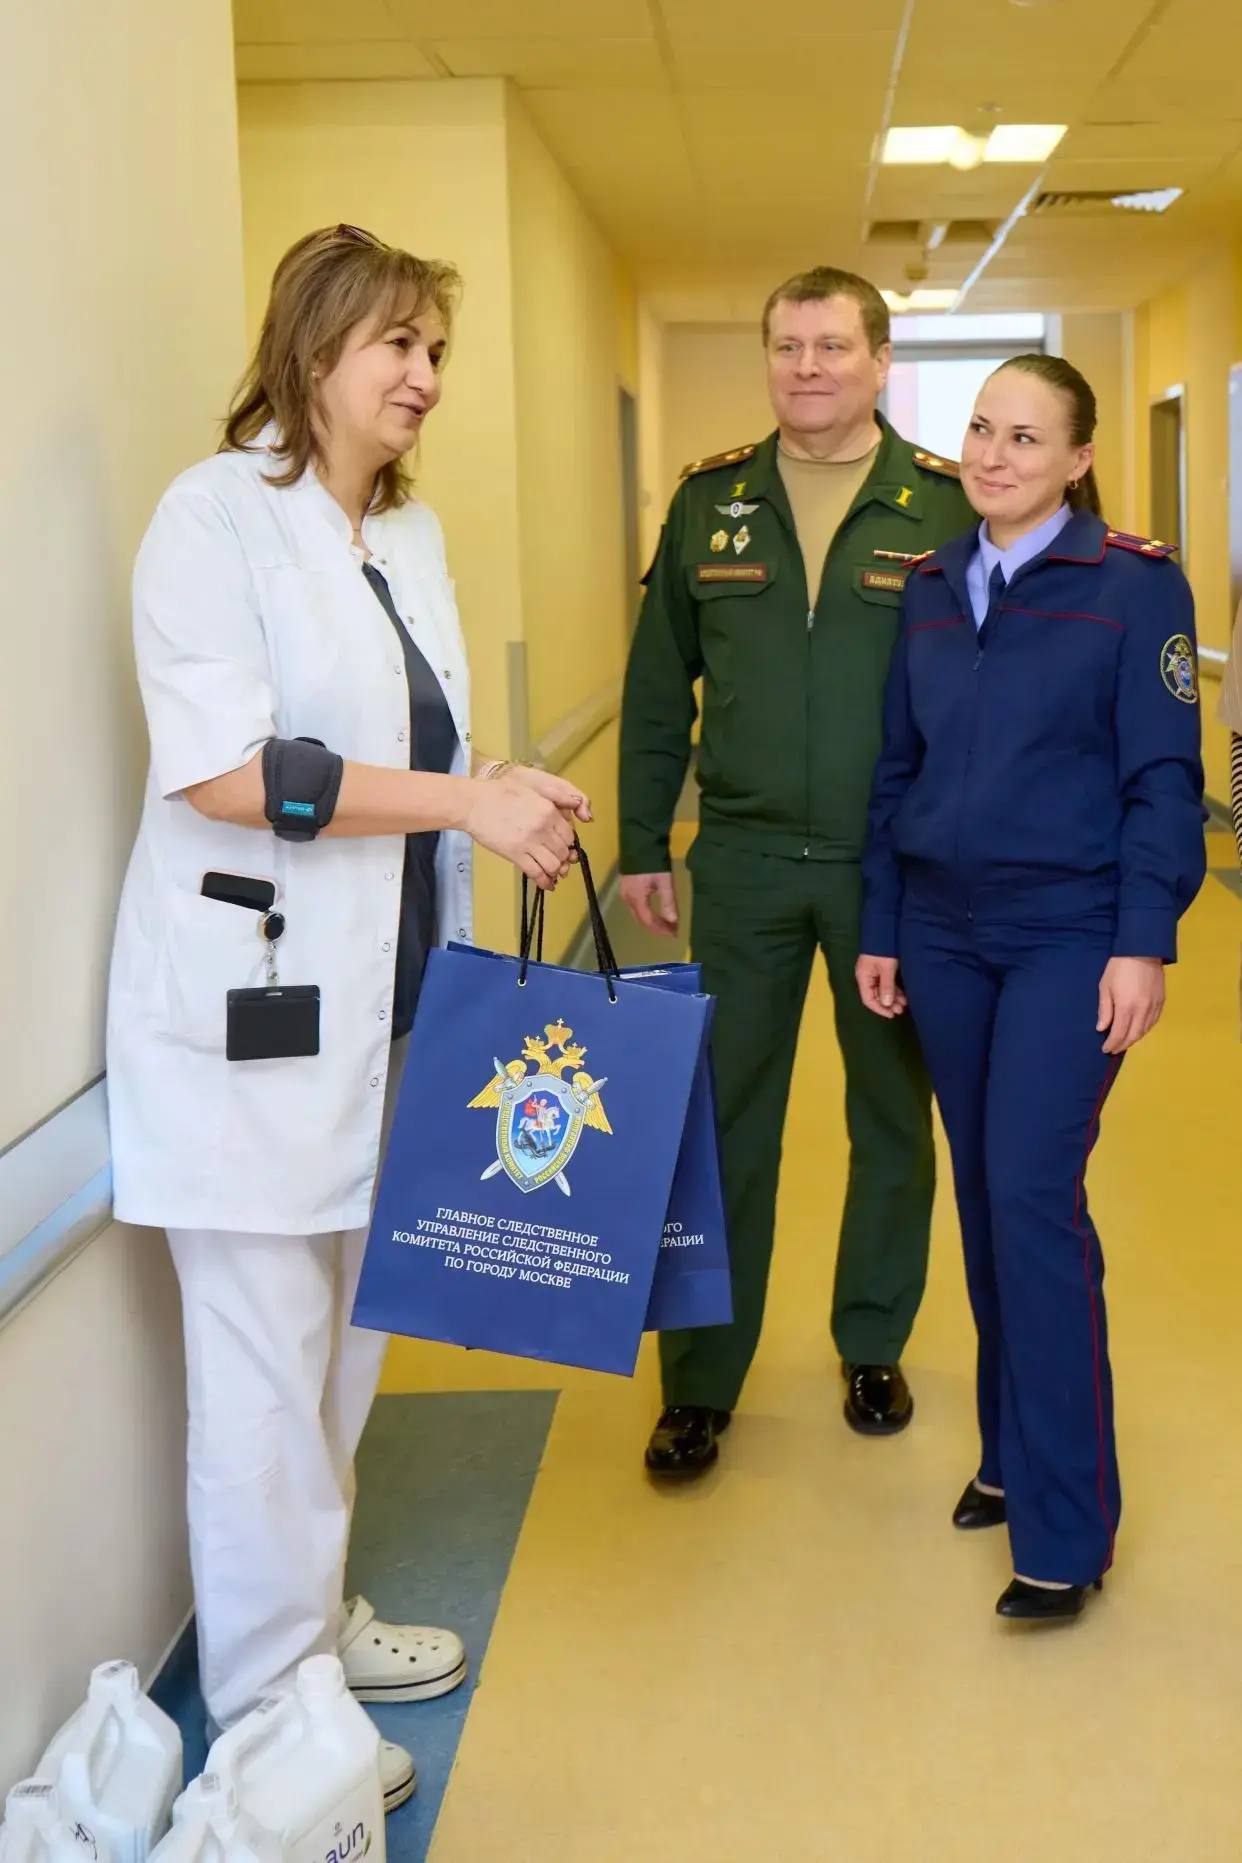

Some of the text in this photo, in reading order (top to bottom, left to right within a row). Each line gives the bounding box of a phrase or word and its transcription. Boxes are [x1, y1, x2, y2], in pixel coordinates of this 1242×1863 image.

[416, 1219, 612, 1265] УПРАВЛЕНИЕ СЛЕДСТВЕННОГО
[436, 1207, 599, 1247] ГЛАВНОЕ СЛЕДСТВЕННОЕ
[392, 1230, 630, 1284] КОМИТЕТА РОССИЙСКОЙ ФЕДЕРАЦИИ
[444, 1256, 572, 1289] ПО ГОРОДУ МОСКВЕ
[312, 1822, 364, 1863] aun
